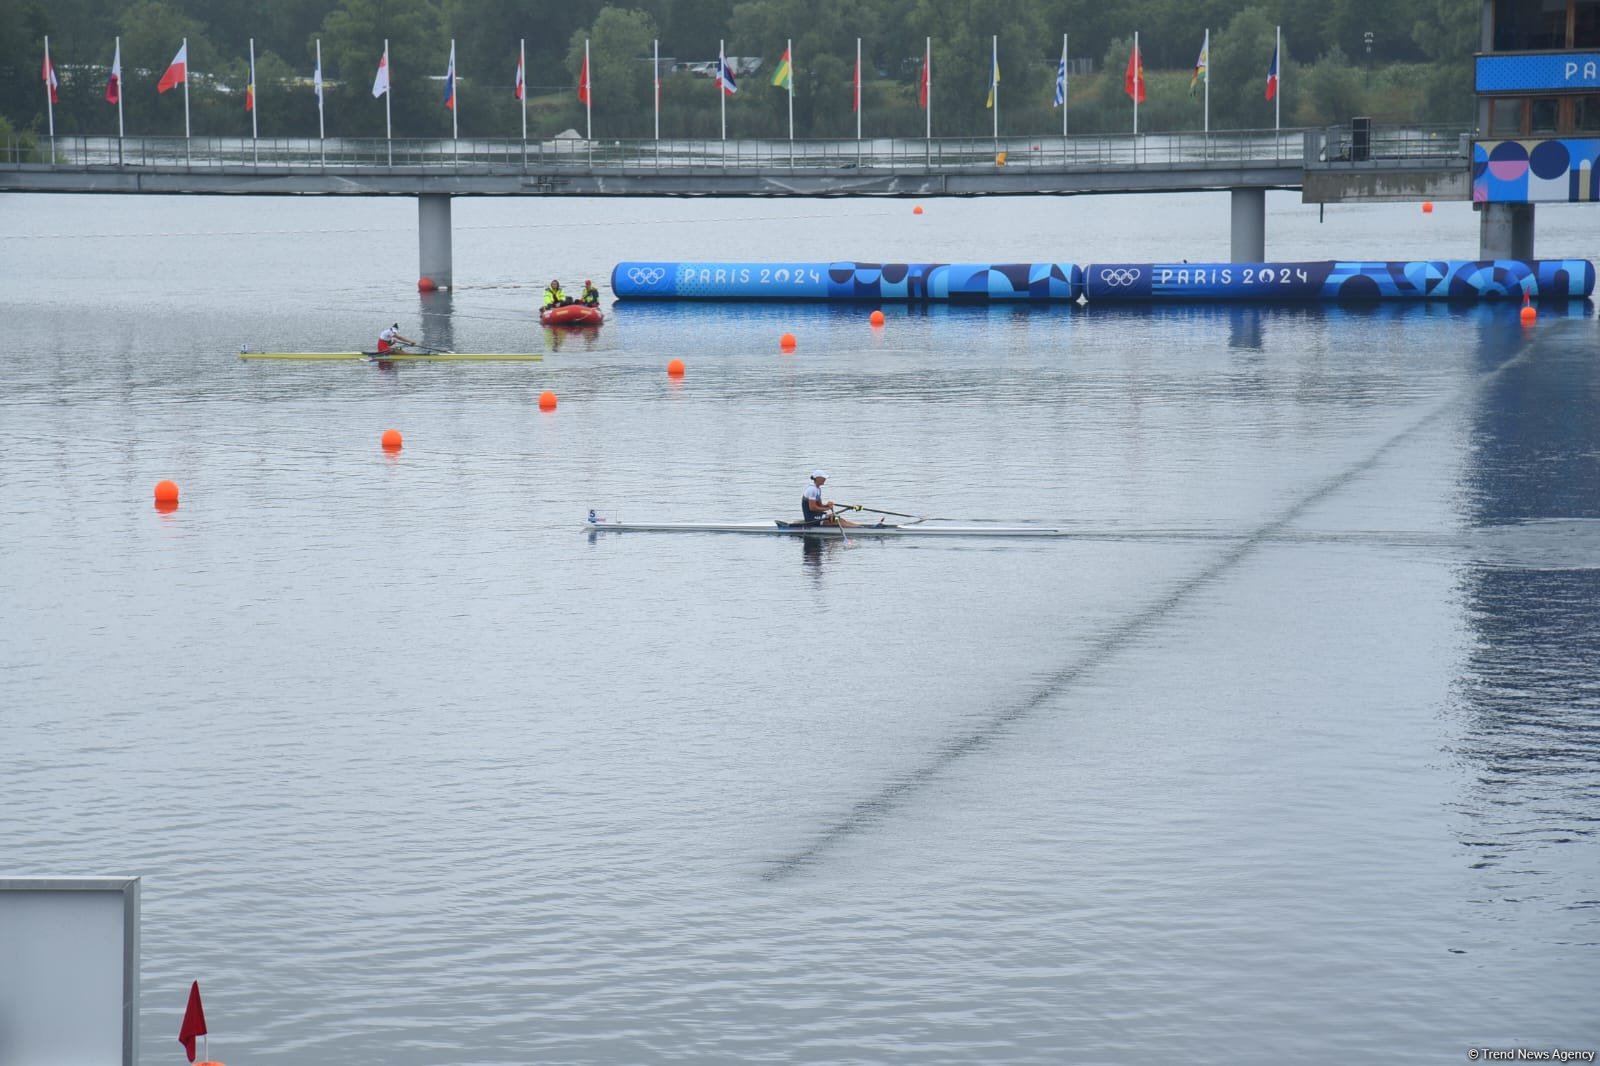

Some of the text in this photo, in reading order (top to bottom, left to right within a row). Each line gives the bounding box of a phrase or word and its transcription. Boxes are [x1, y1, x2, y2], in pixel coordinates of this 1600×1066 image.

[684, 268, 820, 284] PARIS 2024
[1161, 268, 1308, 284] PARIS 2024
